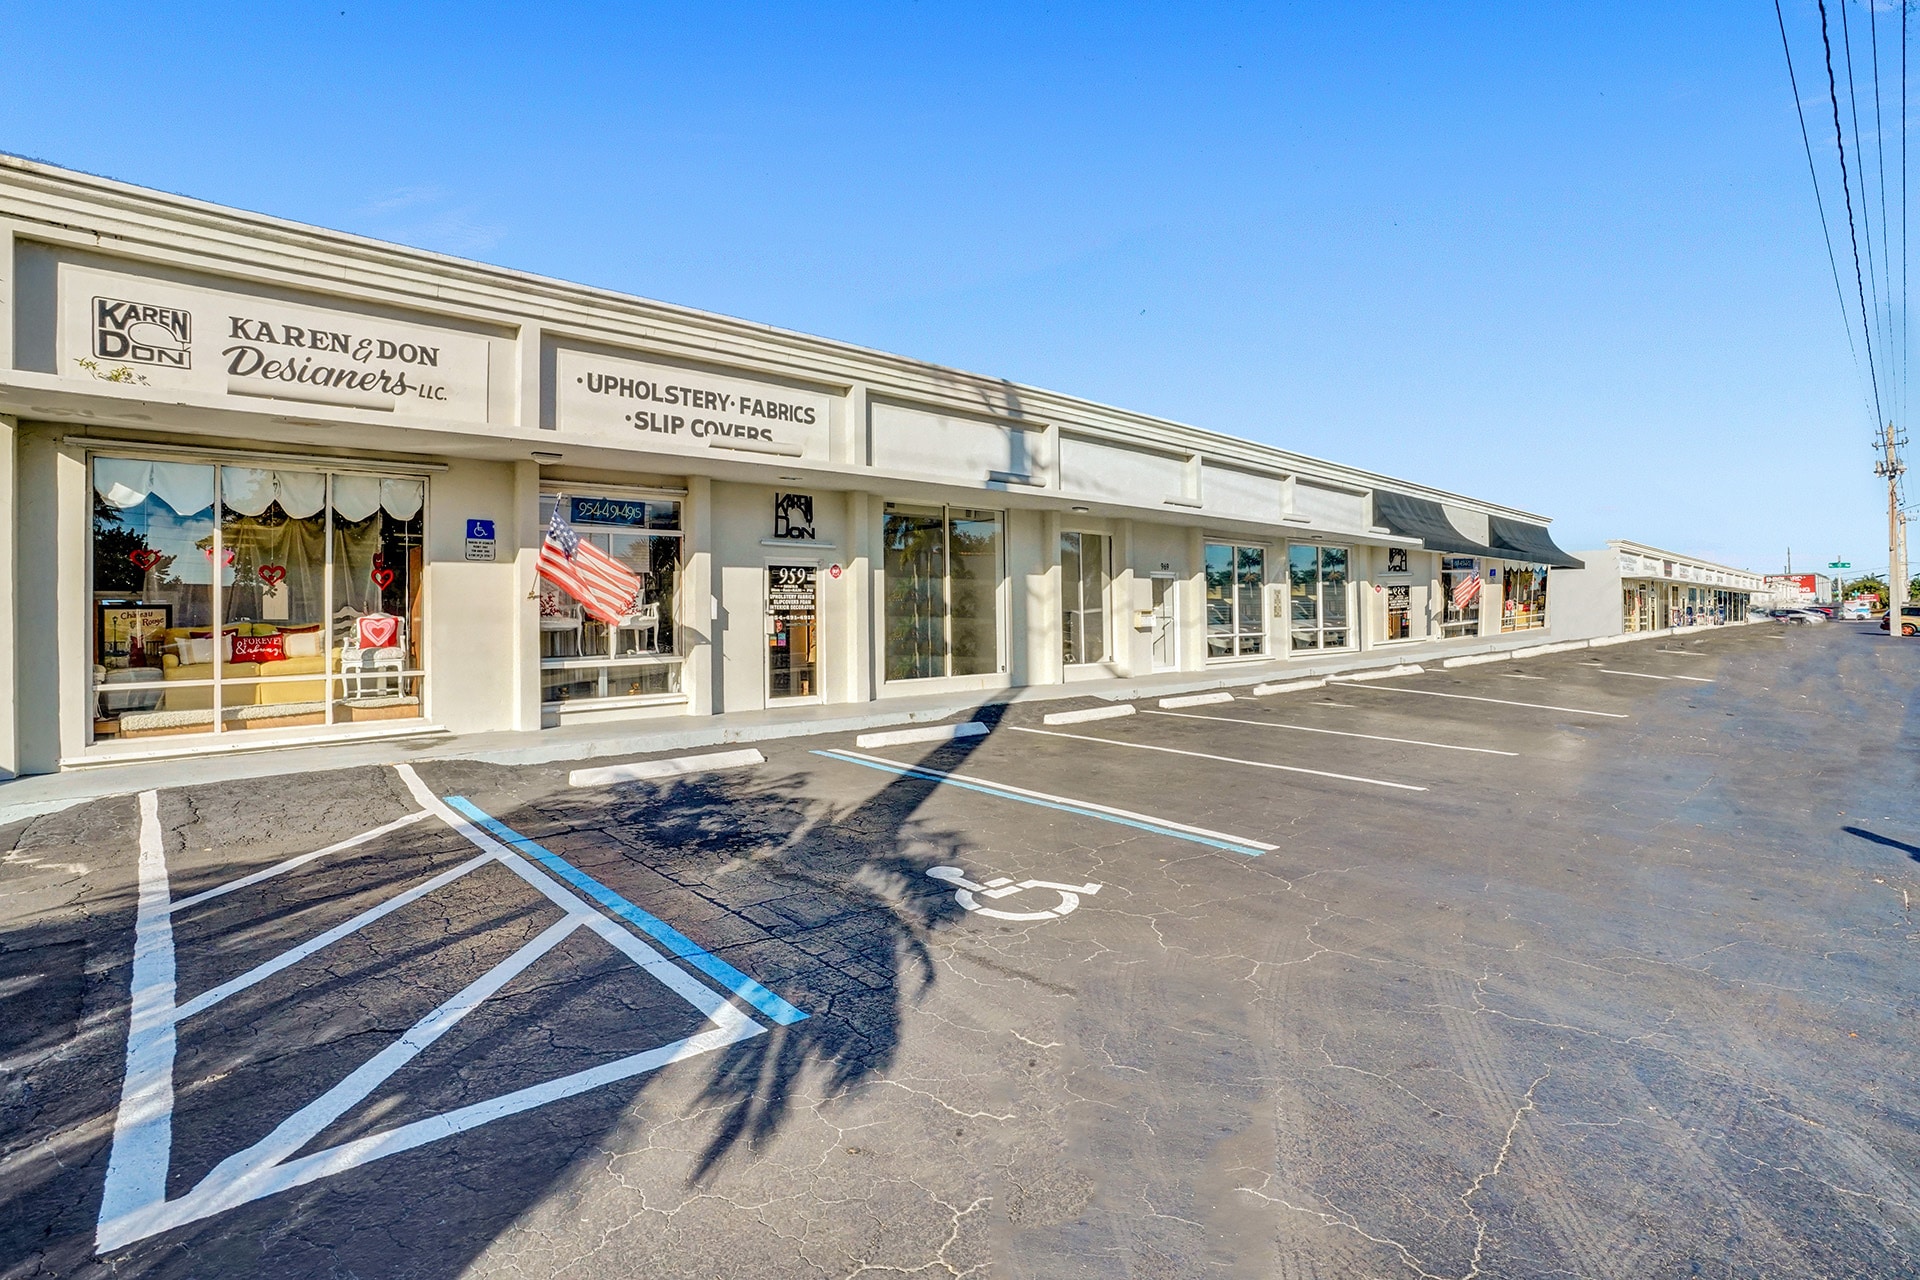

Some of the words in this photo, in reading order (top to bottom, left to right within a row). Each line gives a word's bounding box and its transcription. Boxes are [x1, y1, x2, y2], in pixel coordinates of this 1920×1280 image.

[98, 300, 188, 341] KAREN
[98, 329, 184, 365] DON
[228, 316, 352, 354] KAREN
[352, 338, 373, 363] &
[376, 339, 440, 367] DON
[418, 384, 447, 401] LLC.
[587, 372, 731, 412] UPHOLSTERY
[739, 396, 816, 425] FABRICS
[634, 411, 685, 434] SLIP
[775, 515, 816, 540] DON
[779, 568, 805, 584] 959
